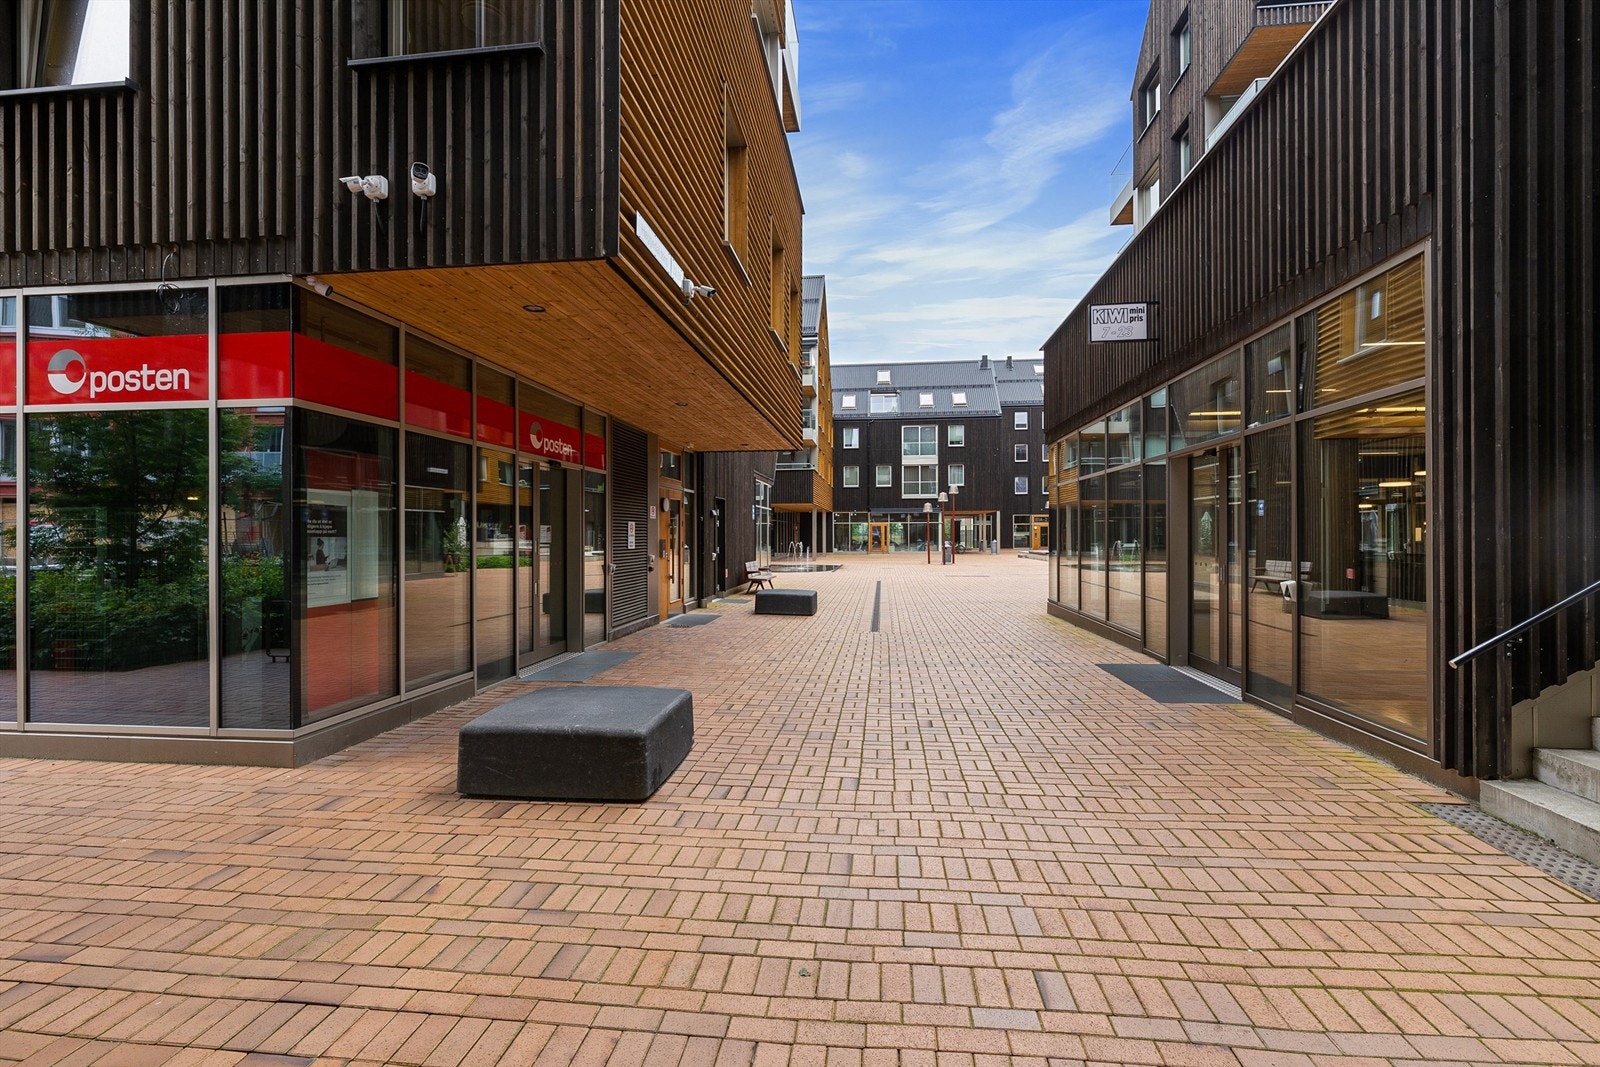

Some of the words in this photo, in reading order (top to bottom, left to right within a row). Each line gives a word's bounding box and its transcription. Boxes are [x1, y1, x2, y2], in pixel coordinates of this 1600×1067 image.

[1092, 308, 1129, 325] KIWI
[1129, 306, 1145, 315] mini
[1129, 315, 1144, 323] pris
[89, 363, 190, 399] posten
[543, 438, 573, 457] posten
